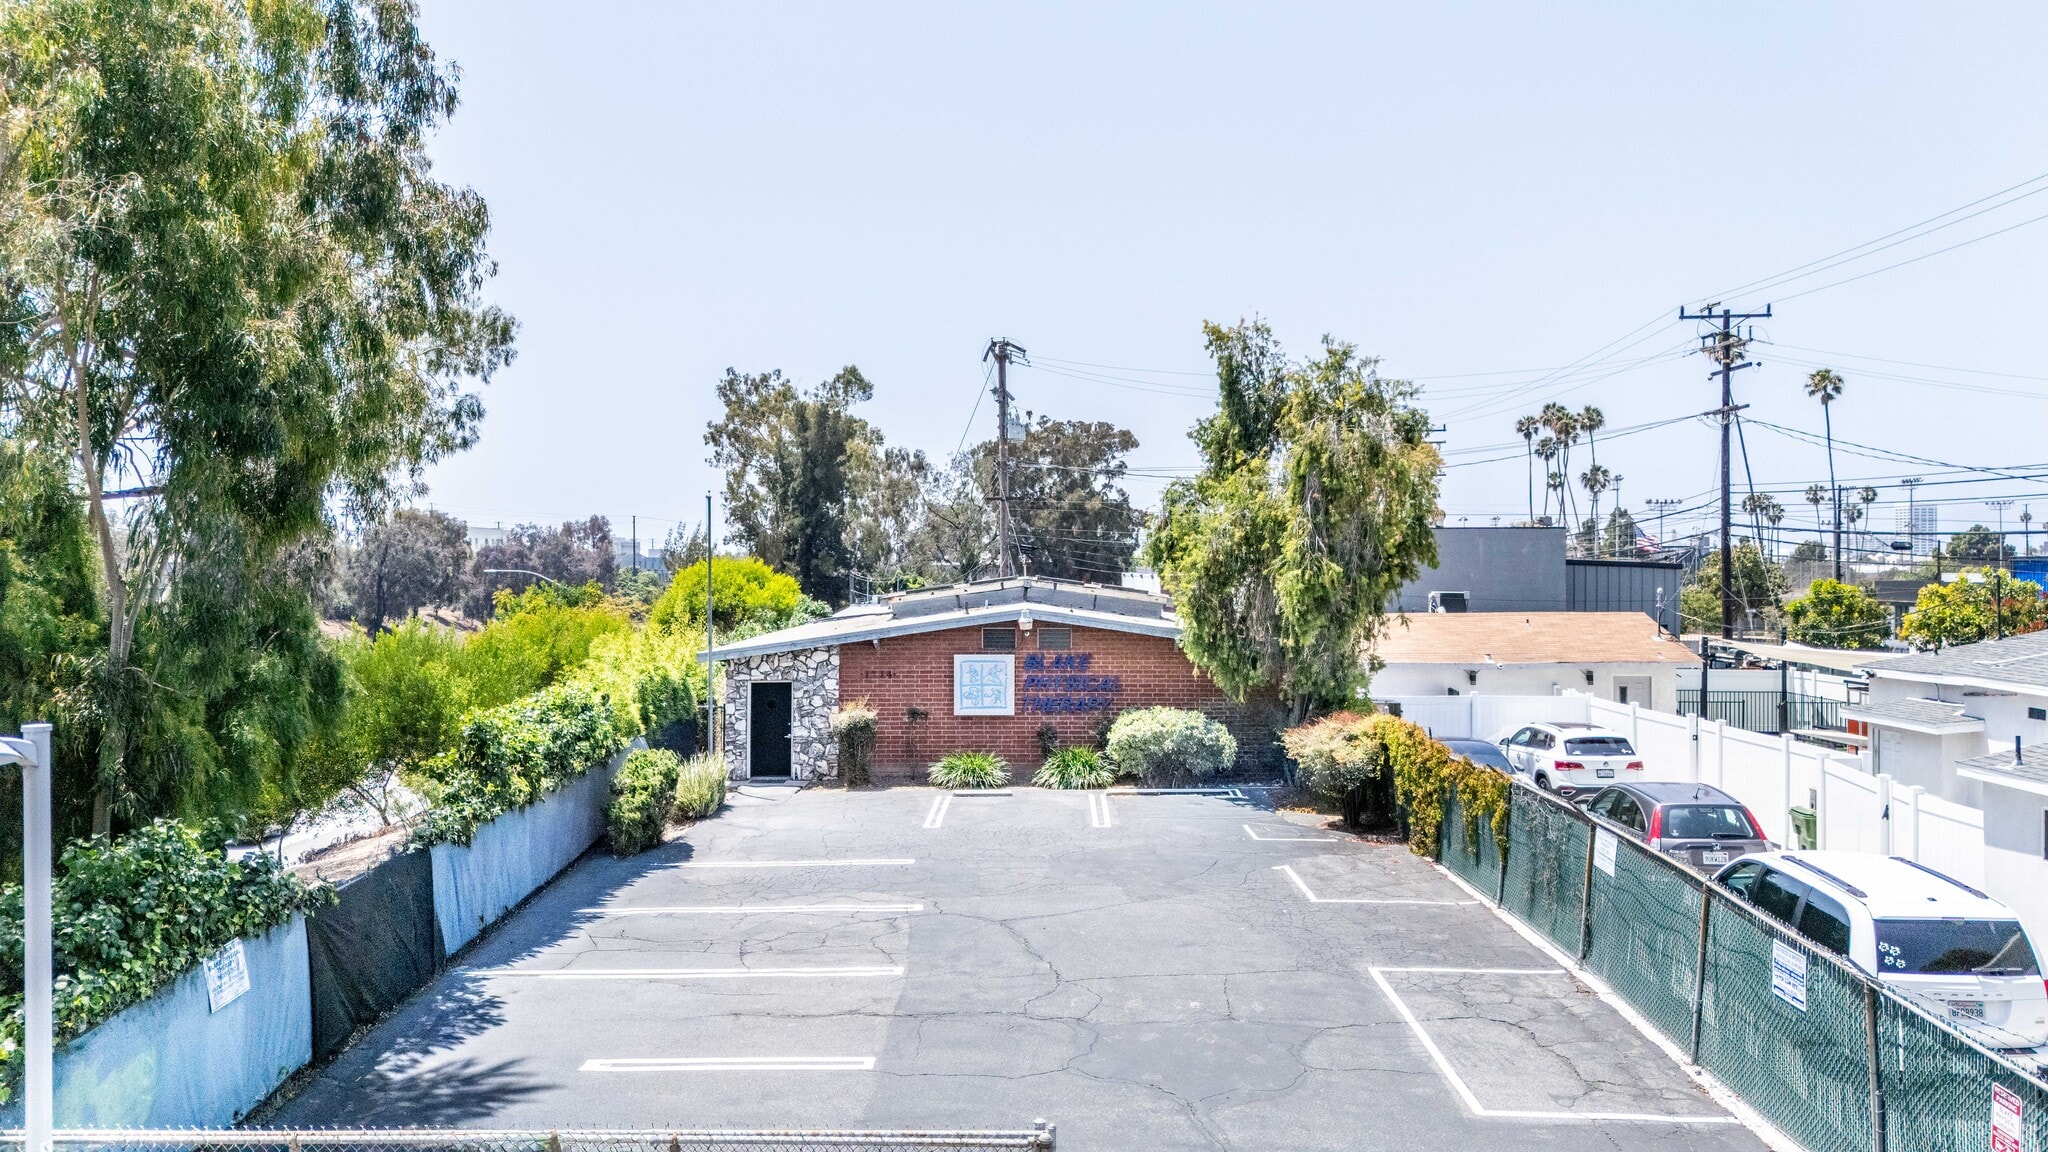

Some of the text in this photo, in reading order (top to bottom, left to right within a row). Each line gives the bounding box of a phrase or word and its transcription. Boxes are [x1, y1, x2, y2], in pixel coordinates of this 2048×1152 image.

[1025, 653, 1091, 670] BLAKE
[1024, 675, 1119, 691] PHYSICAL
[1023, 697, 1114, 712] THERAPY
